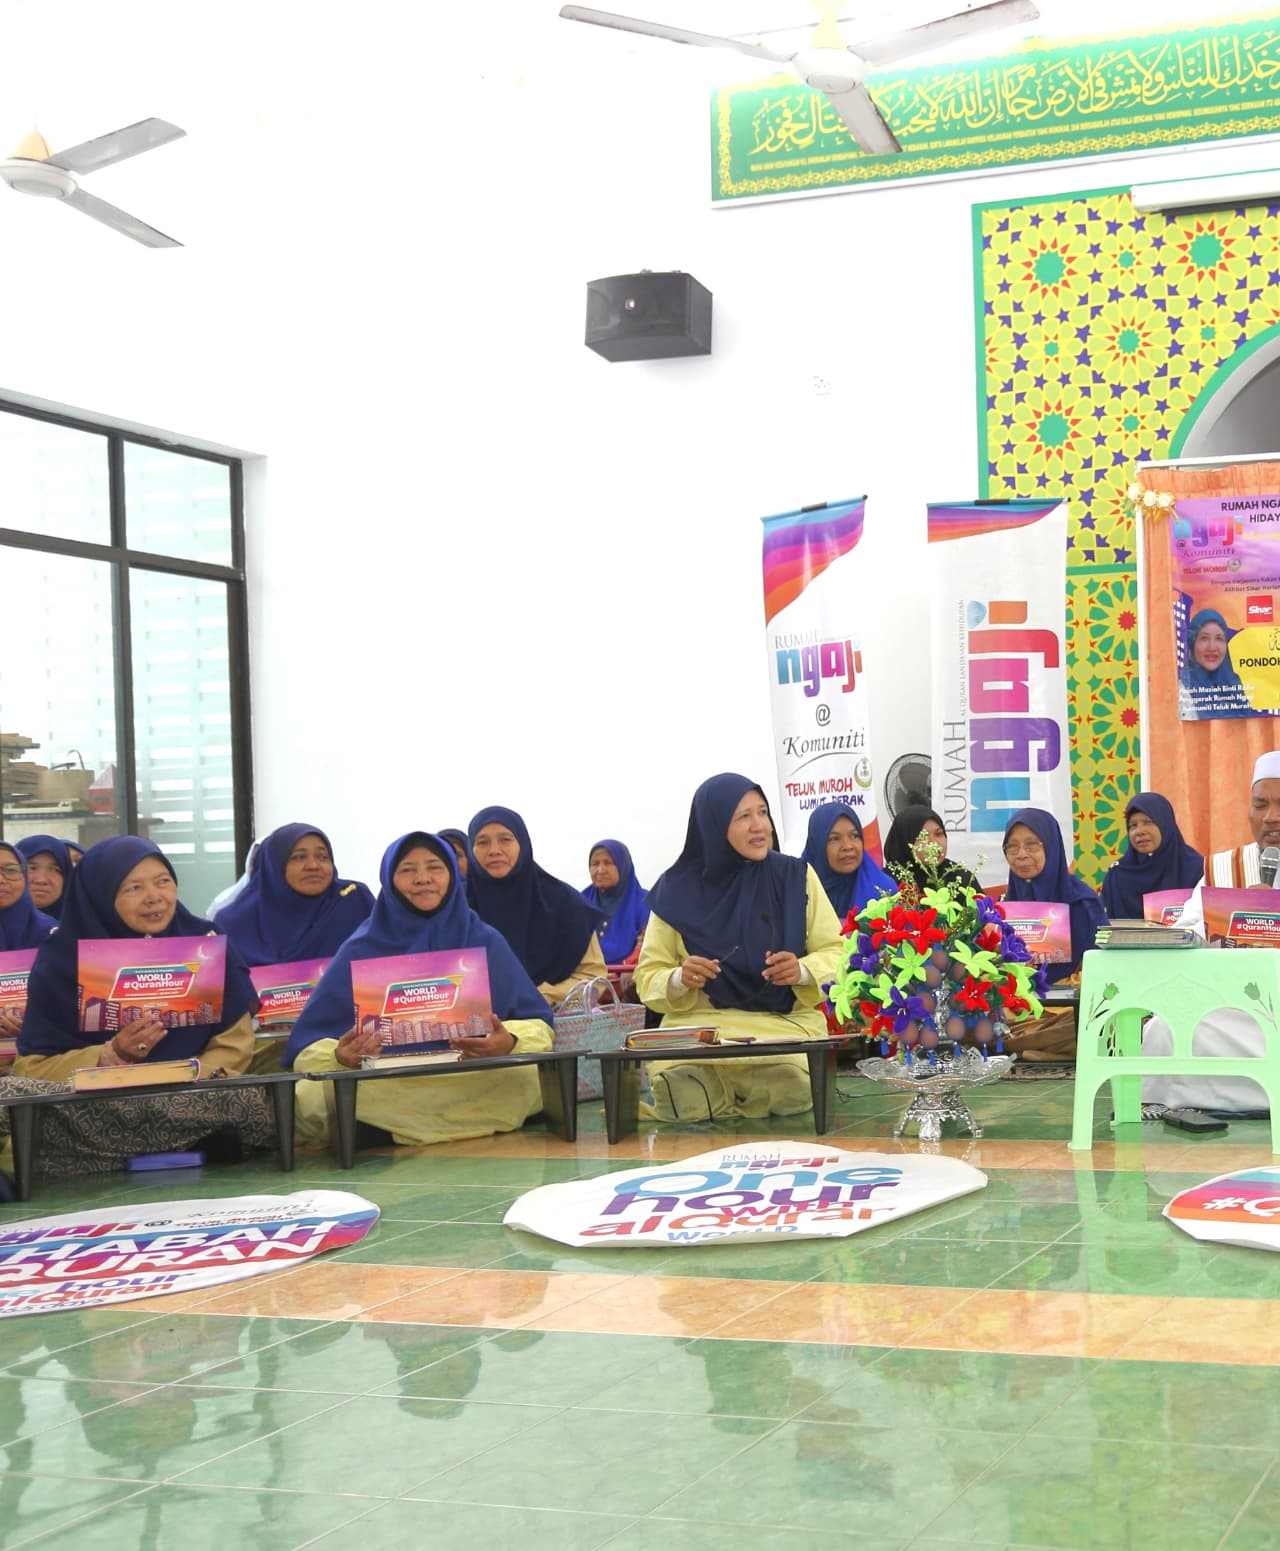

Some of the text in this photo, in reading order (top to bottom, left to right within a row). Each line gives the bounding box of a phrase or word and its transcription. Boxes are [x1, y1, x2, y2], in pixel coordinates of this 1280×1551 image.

[1221, 501, 1259, 512] RUMAH
[776, 639, 863, 698] ngaji
[816, 703, 831, 727] @
[967, 600, 1061, 832] ngaji
[783, 728, 865, 758] Komuniti
[943, 720, 967, 833] RUMAH
[785, 777, 853, 798] TELUK MUROH
[1246, 917, 1275, 926] WORLD
[123, 979, 185, 991] #QuranHour
[136, 973, 173, 982] WORLD
[272, 990, 302, 1000] WORLD
[393, 992, 449, 1005] #QuranHour
[404, 986, 438, 996] WORLD
[614, 1167, 904, 1197] One
[600, 1182, 901, 1216] hour
[721, 1199, 856, 1218] with
[55, 1271, 196, 1293] hour
